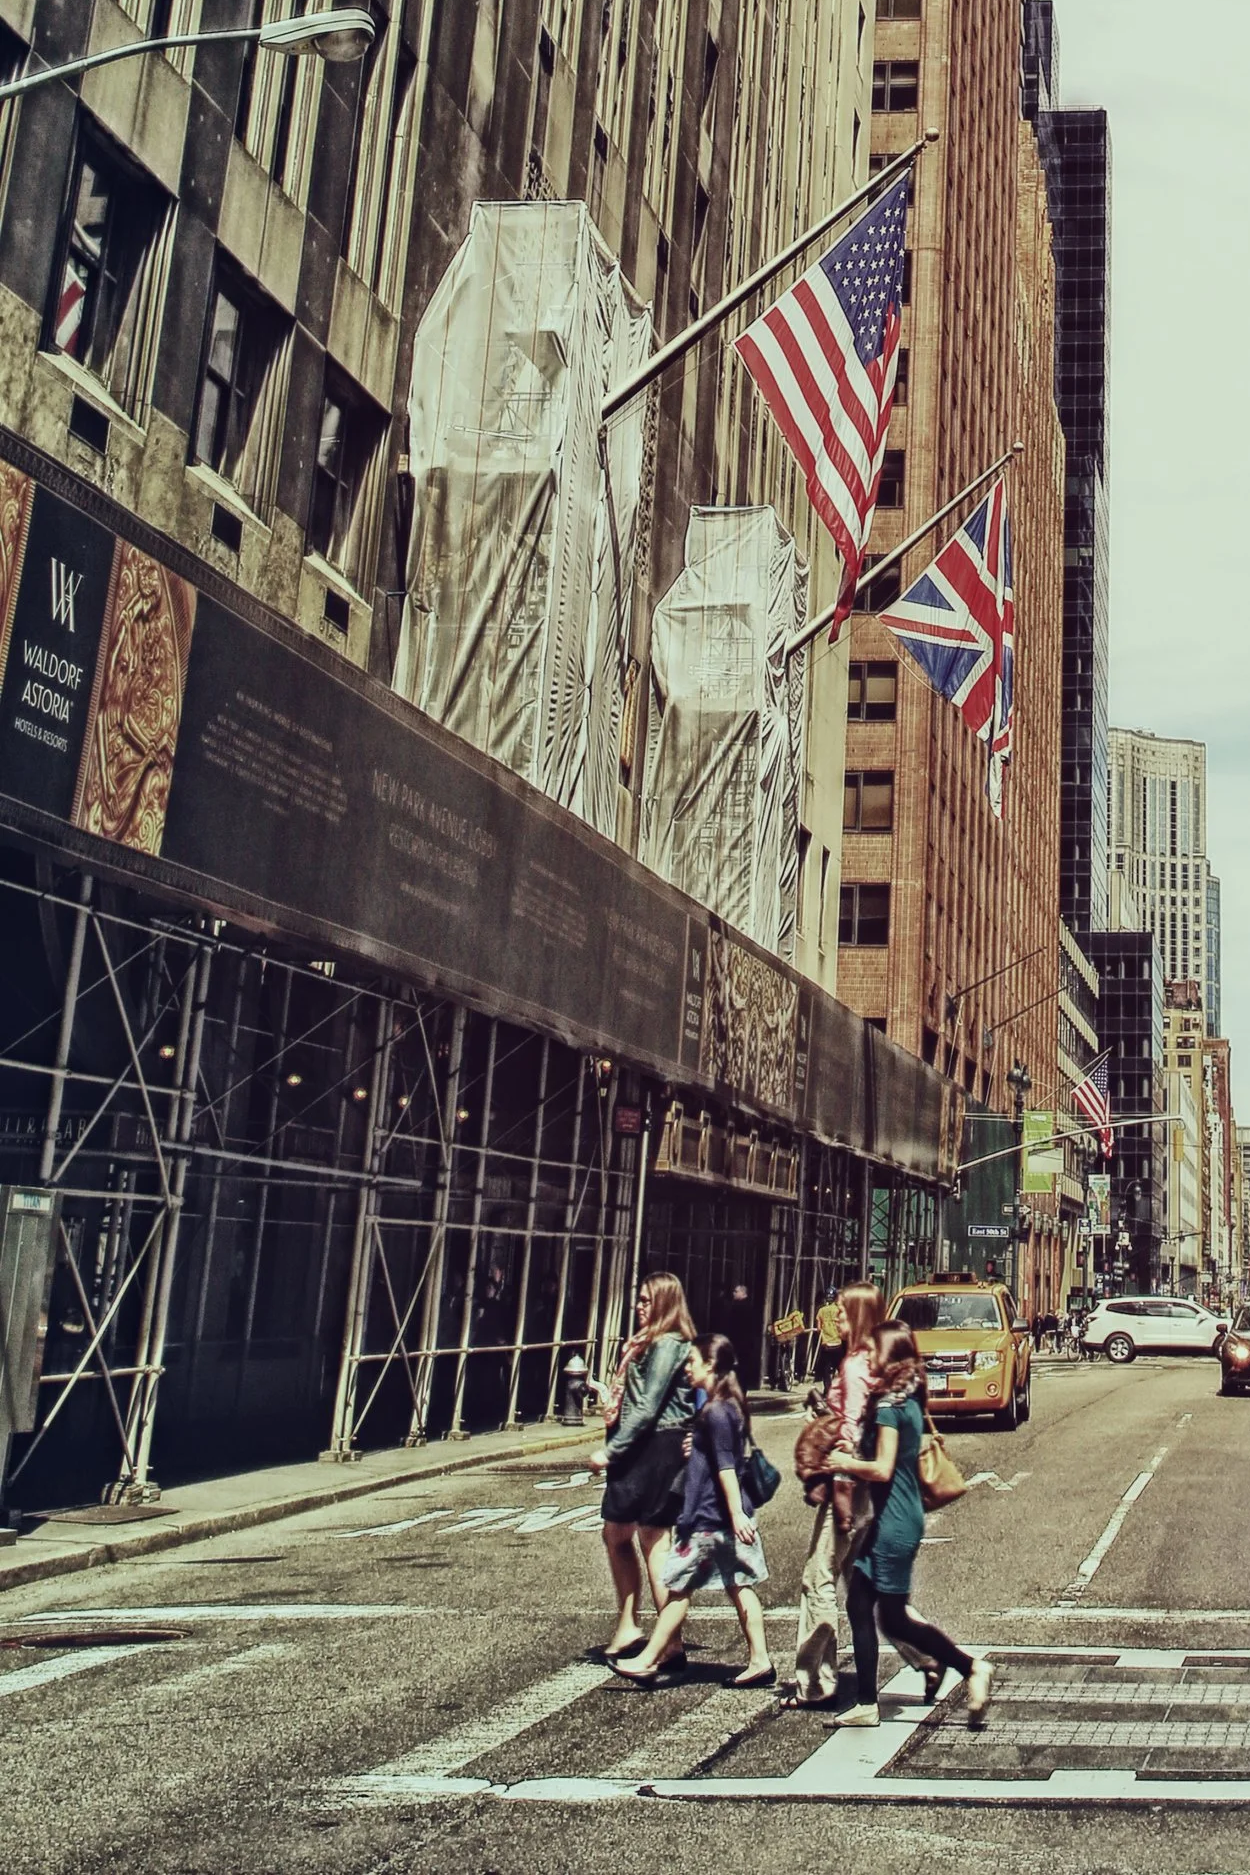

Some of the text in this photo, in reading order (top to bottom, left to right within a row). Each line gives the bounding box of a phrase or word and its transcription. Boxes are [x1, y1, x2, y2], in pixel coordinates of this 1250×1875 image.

[24, 639, 83, 690] WALDORF
[14, 717, 38, 739] HOTELS
[42, 729, 68, 753] RESORTS
[401, 784, 425, 822] PARK
[972, 1227, 985, 1235] East
